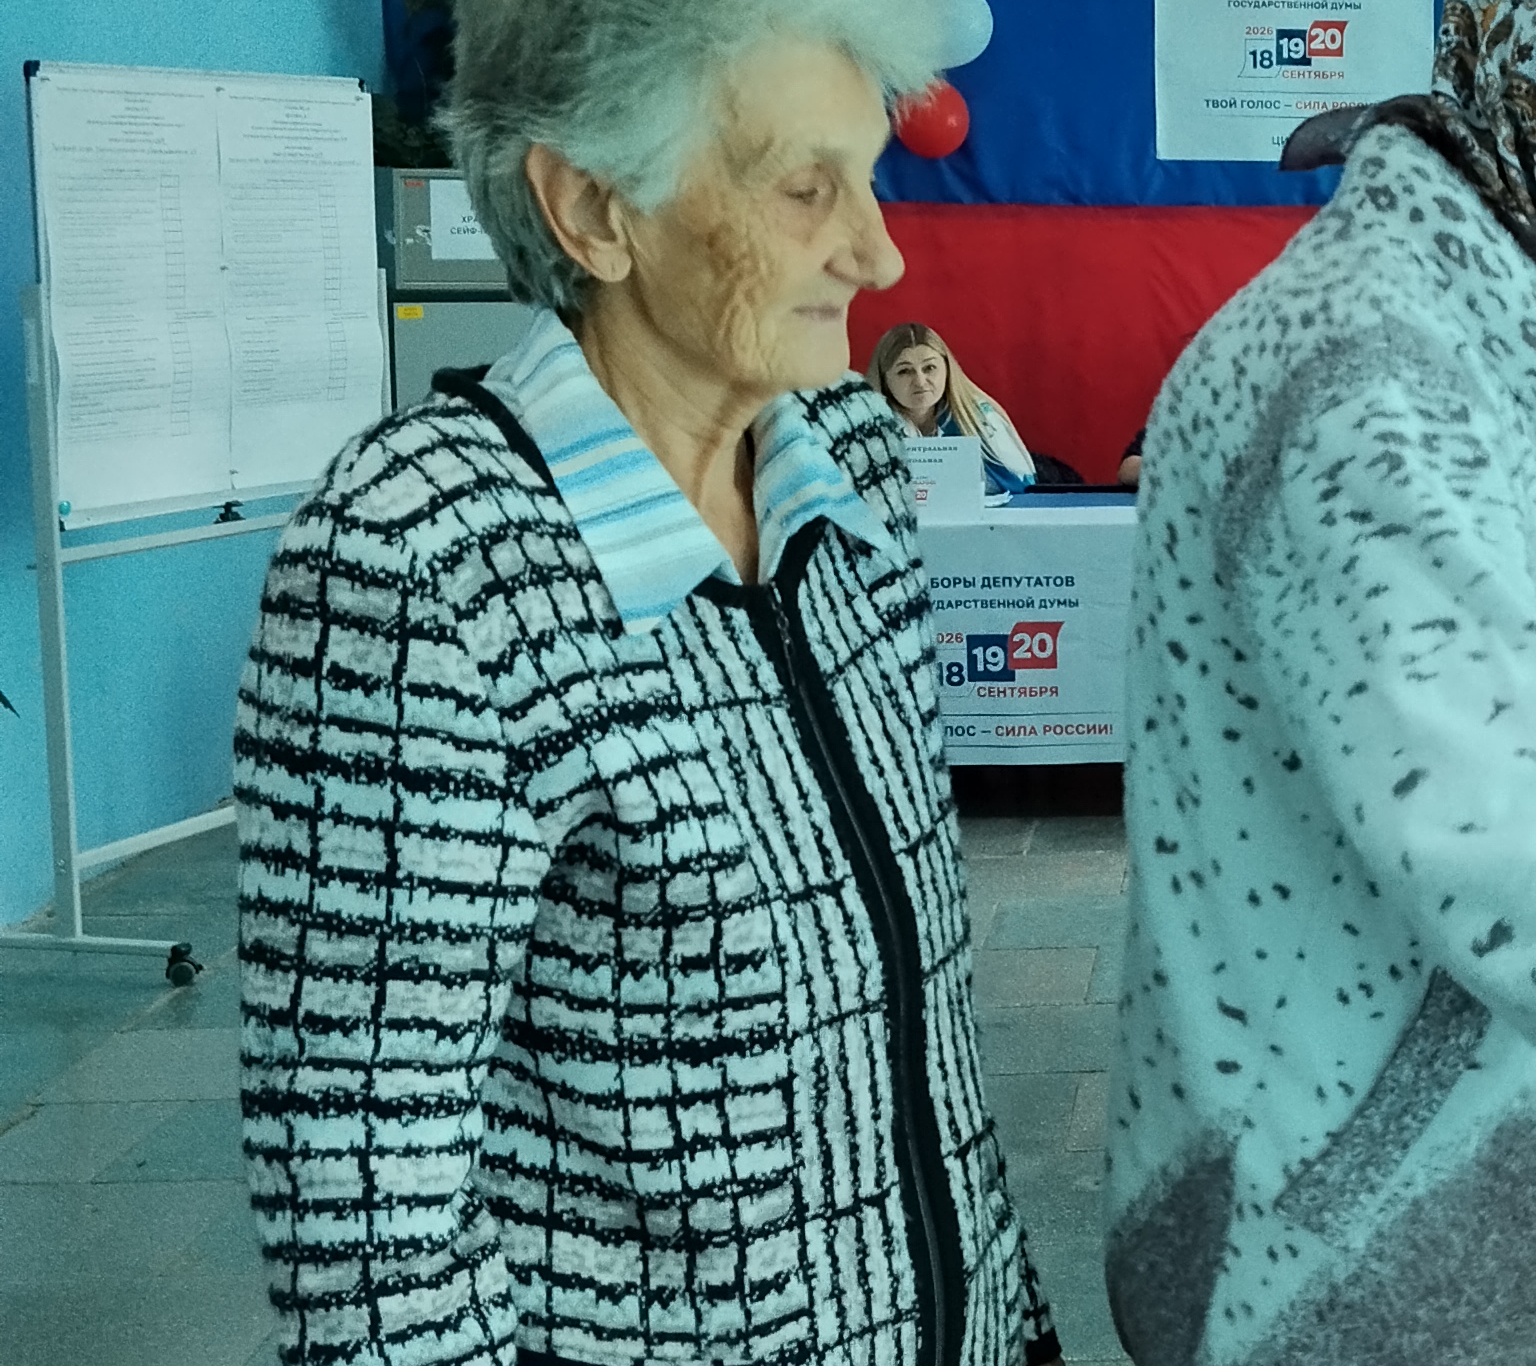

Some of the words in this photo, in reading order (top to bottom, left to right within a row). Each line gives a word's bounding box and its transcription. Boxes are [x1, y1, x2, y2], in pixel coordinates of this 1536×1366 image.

[1227, 0, 1328, 10] ГОСУДАРСТВЕННОЙ
[1331, 1, 1362, 10] ДУМЫ
[1245, 26, 1273, 35] 2026
[1249, 49, 1273, 69] 18
[1279, 37, 1305, 59] 19
[1310, 28, 1342, 50] 20
[1282, 70, 1345, 80] СЕНТЯБРЯ
[1204, 97, 1237, 109] ТВОЙ
[1240, 99, 1281, 110] ГОЛОС
[1295, 101, 1328, 111] СИЛА
[930, 577, 976, 589] БОРЫ
[980, 575, 1076, 589] ДЕПУТАТОВ
[1038, 598, 1079, 609] ДУМЫ
[937, 632, 964, 644] 026
[971, 645, 1006, 672] 19
[1012, 632, 1054, 659] 20
[976, 686, 1059, 698] СЕНТЯБРЯ
[944, 726, 976, 737] ЛОС
[995, 725, 1036, 737] СИЛА
[1043, 723, 1113, 736] РОССИИ!
